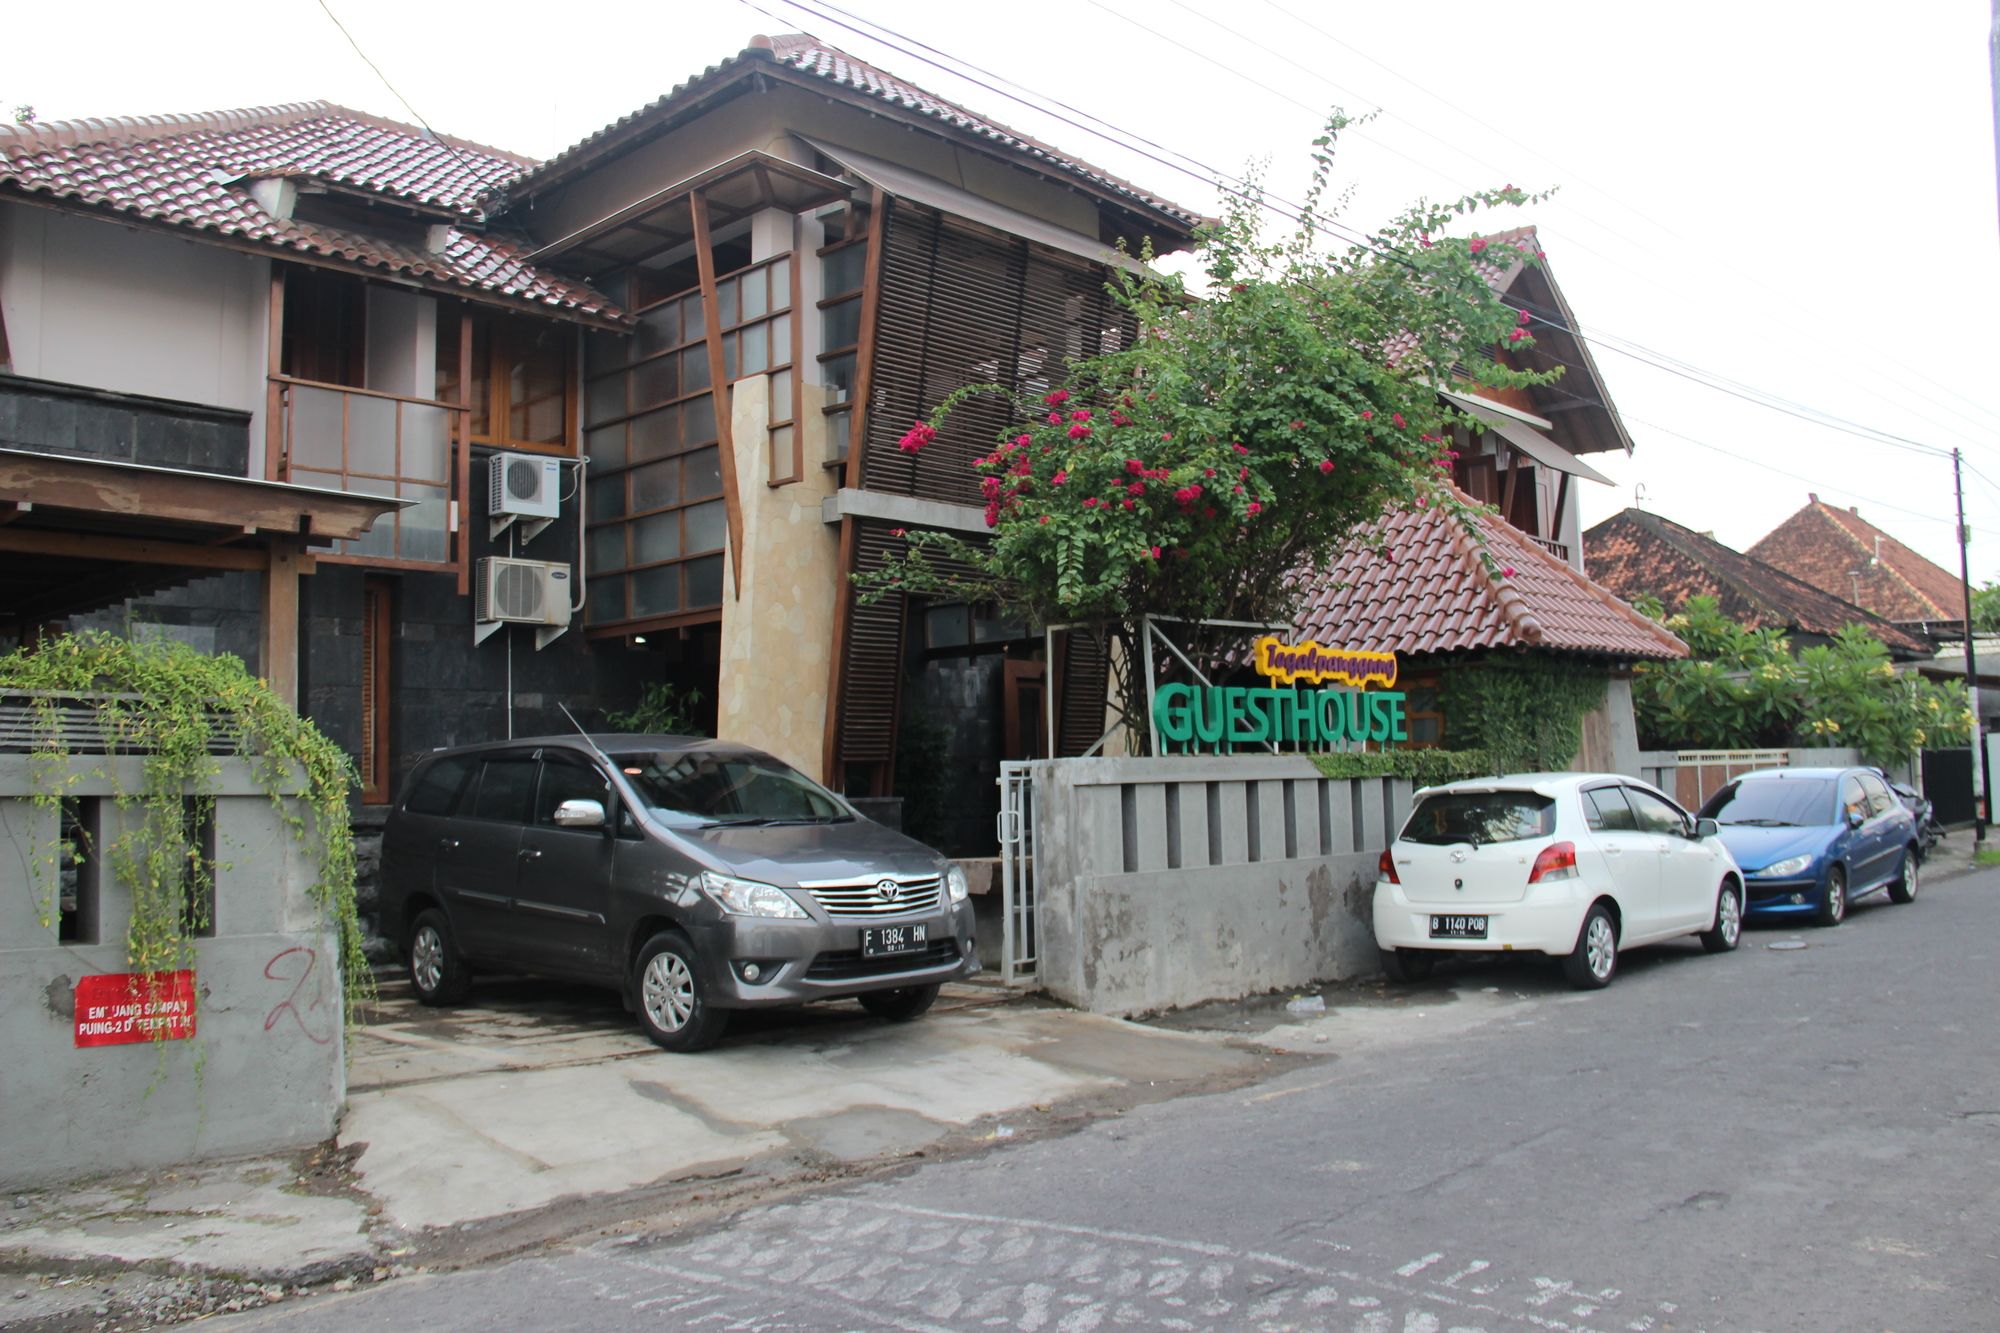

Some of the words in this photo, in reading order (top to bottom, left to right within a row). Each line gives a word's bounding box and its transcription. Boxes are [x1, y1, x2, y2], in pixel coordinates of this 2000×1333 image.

[1266, 644, 1395, 680] Tegalpanggung
[1153, 683, 1407, 743] GUESTHOUSE
[1432, 917, 1439, 930] B
[1445, 917, 1466, 930] 1140
[865, 930, 872, 947] F
[881, 928, 904, 945] 1384
[913, 924, 926, 942] HN
[79, 1020, 122, 1035] PUING-2
